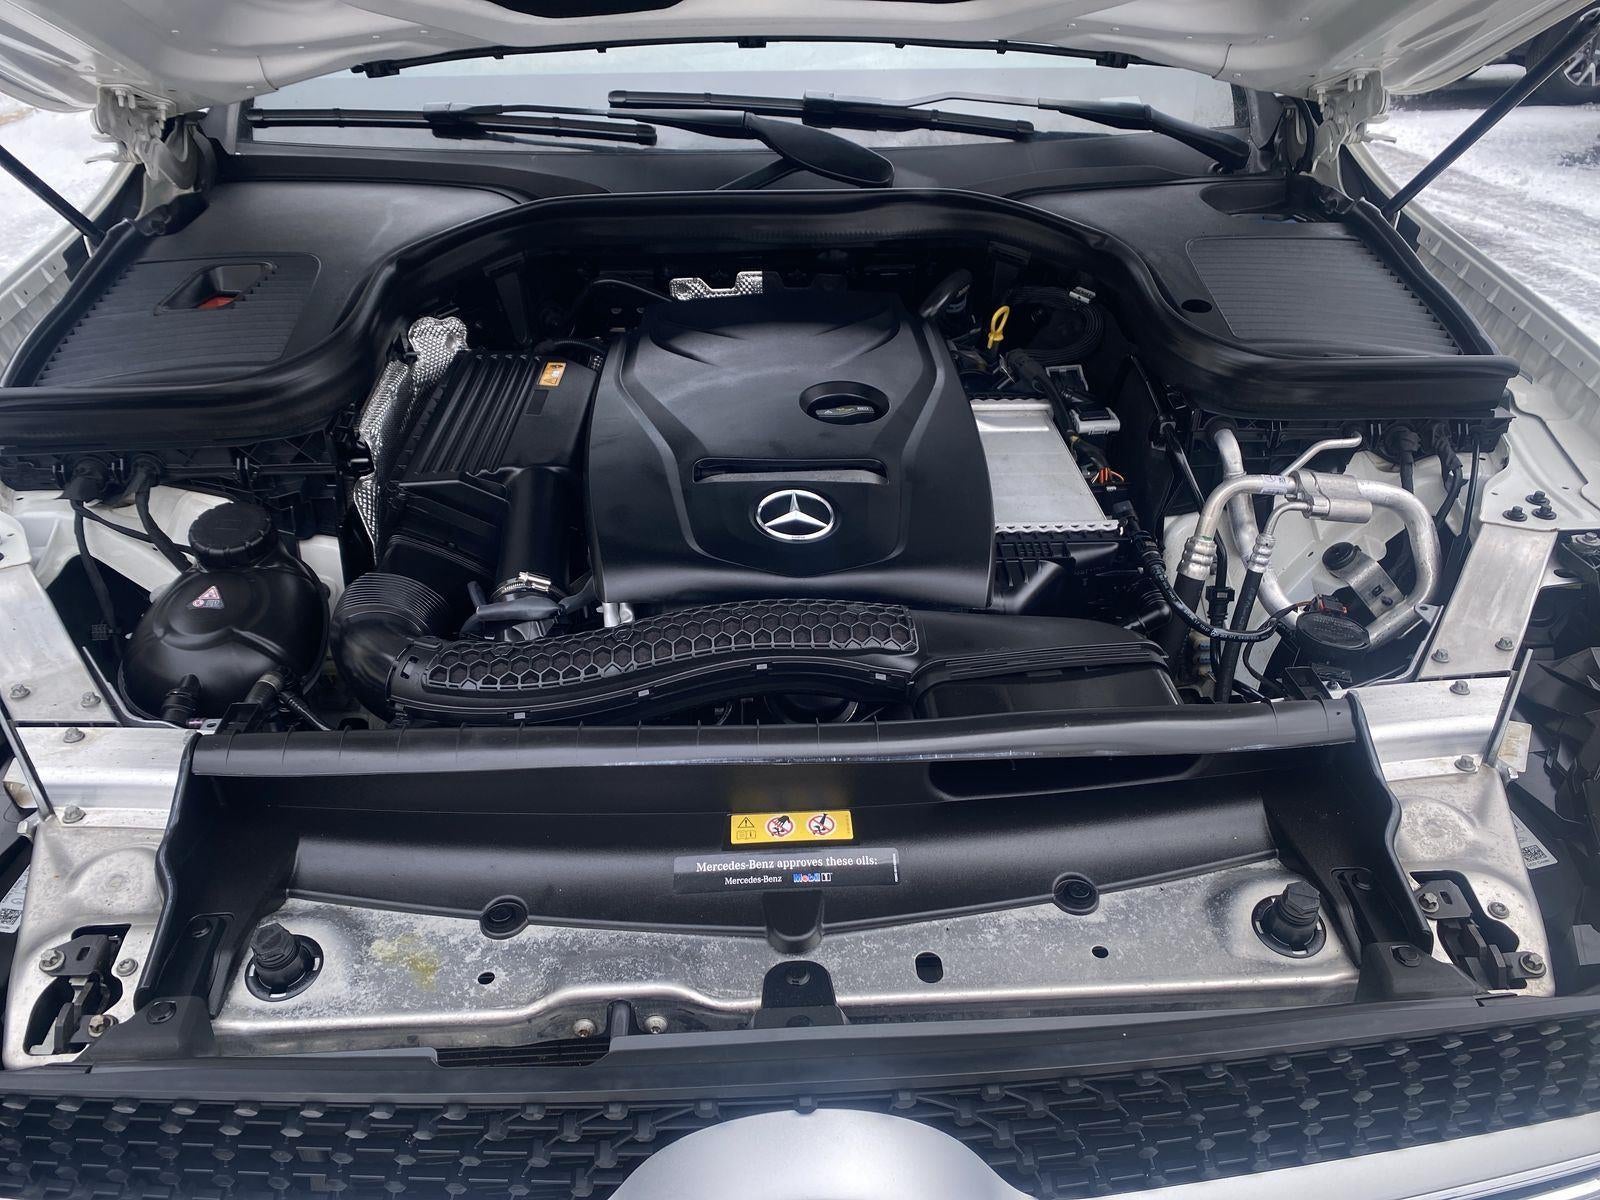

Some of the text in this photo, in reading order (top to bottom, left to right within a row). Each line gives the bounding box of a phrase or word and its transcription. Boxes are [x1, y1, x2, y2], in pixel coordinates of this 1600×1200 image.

[696, 855, 878, 872] Mercedes-Benz approves these oils:
[724, 875, 783, 886] Mercedes-Benz
